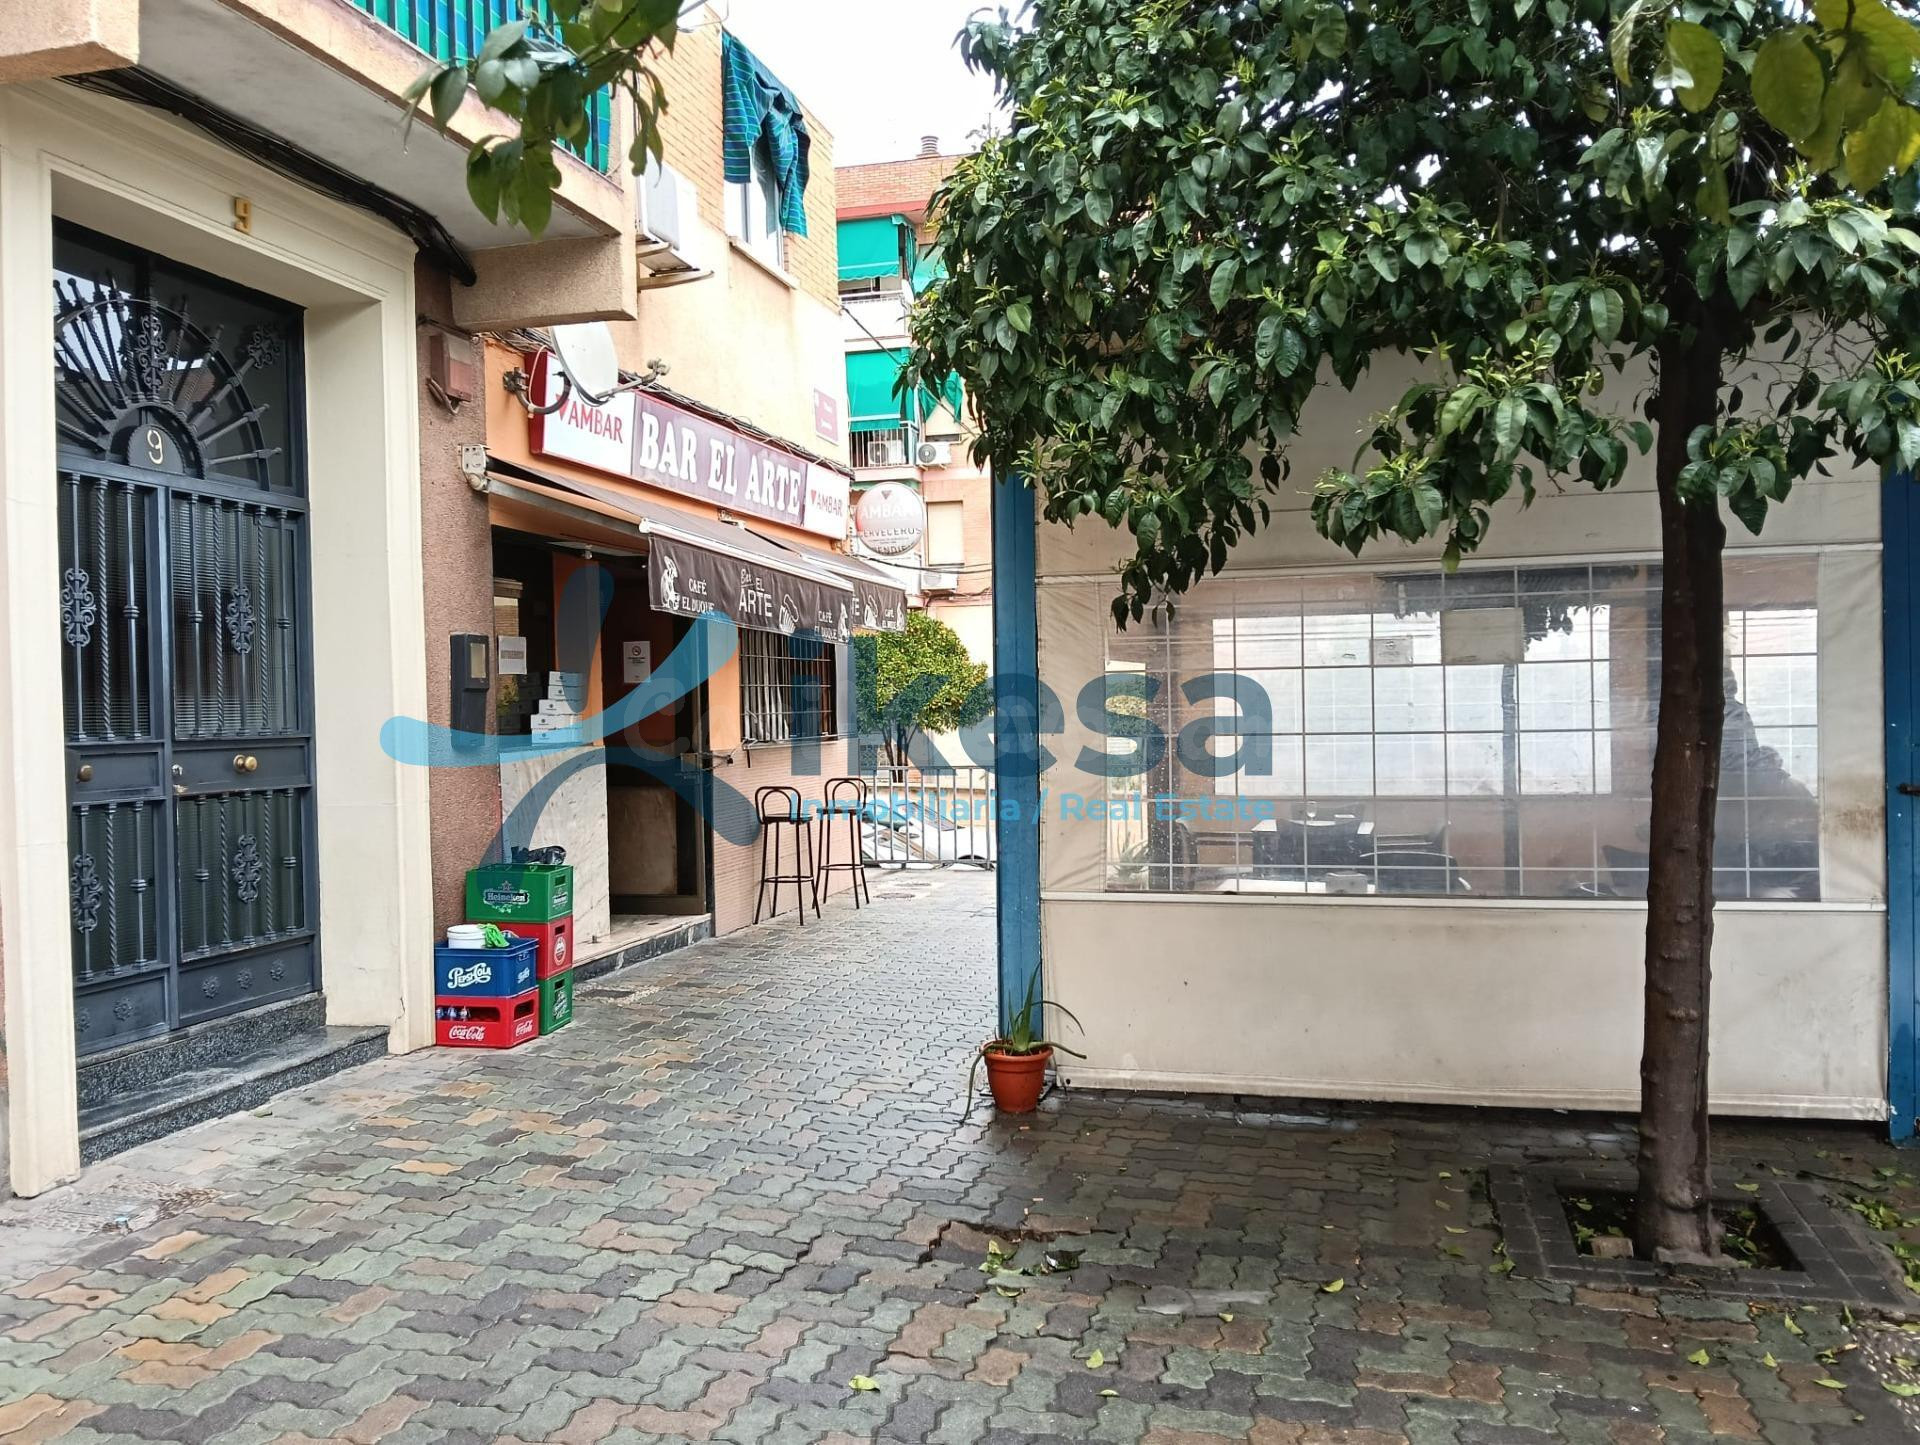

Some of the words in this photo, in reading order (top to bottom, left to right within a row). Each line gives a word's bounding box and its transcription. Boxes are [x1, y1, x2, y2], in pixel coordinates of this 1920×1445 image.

[568, 400, 623, 444] AMBAR
[147, 429, 163, 464] 9
[639, 411, 698, 484] BAR
[707, 437, 738, 497] EL
[744, 453, 802, 516] ARTE
[816, 491, 843, 517] AMBAR
[688, 577, 707, 595] CAFÉ
[755, 577, 765, 592] EL
[682, 596, 690, 610] EL
[738, 588, 773, 617] ARTE
[487, 892, 527, 902] Heineken
